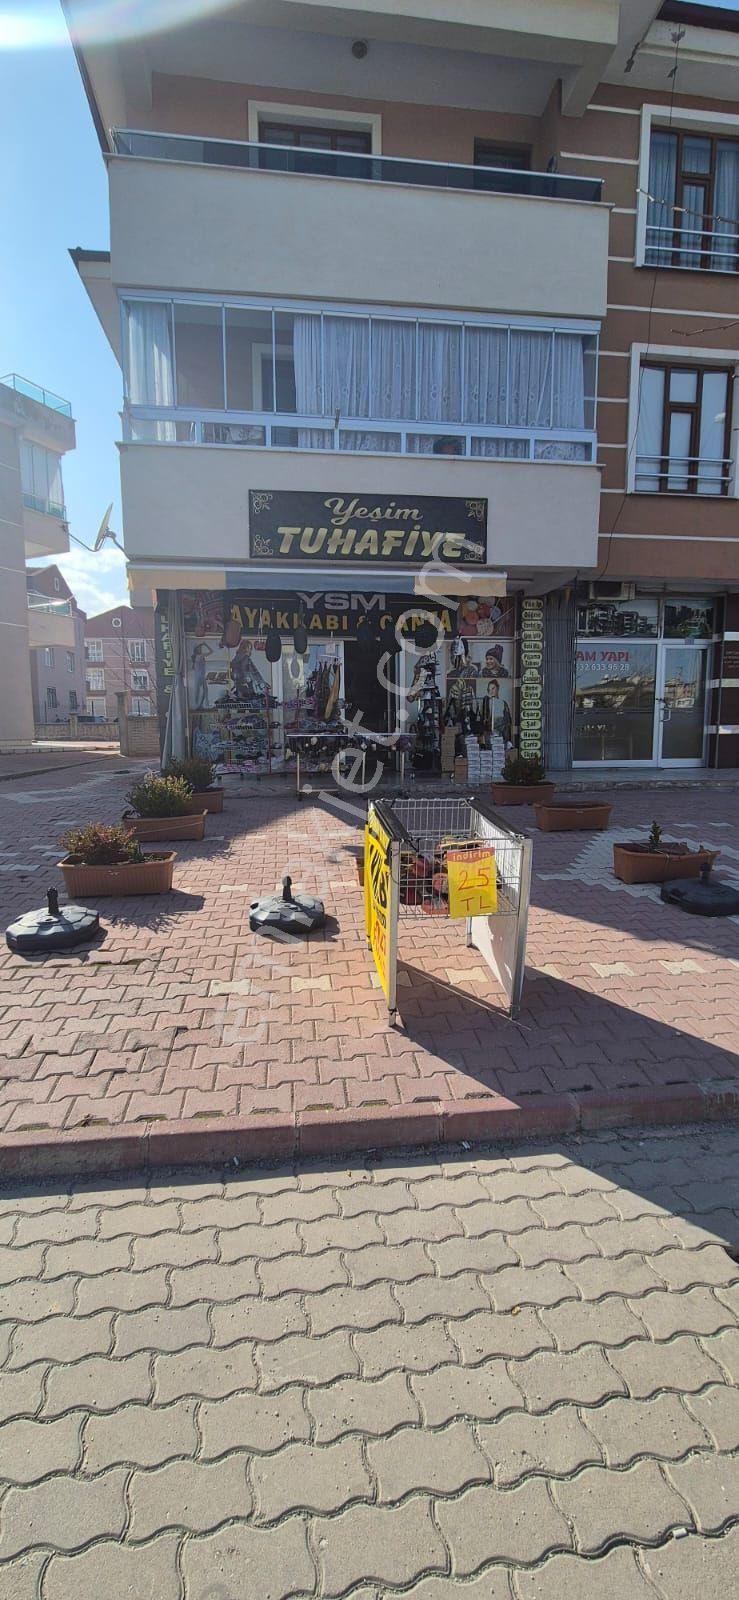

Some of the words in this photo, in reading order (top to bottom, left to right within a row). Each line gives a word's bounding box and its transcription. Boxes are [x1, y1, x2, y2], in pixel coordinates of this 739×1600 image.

[324, 497, 424, 526] Yeşim
[277, 524, 466, 559] TUHAFİYE
[296, 592, 387, 611] YSM
[600, 651, 630, 663] YAPI
[458, 867, 490, 891] 25
[460, 895, 492, 912] TL
